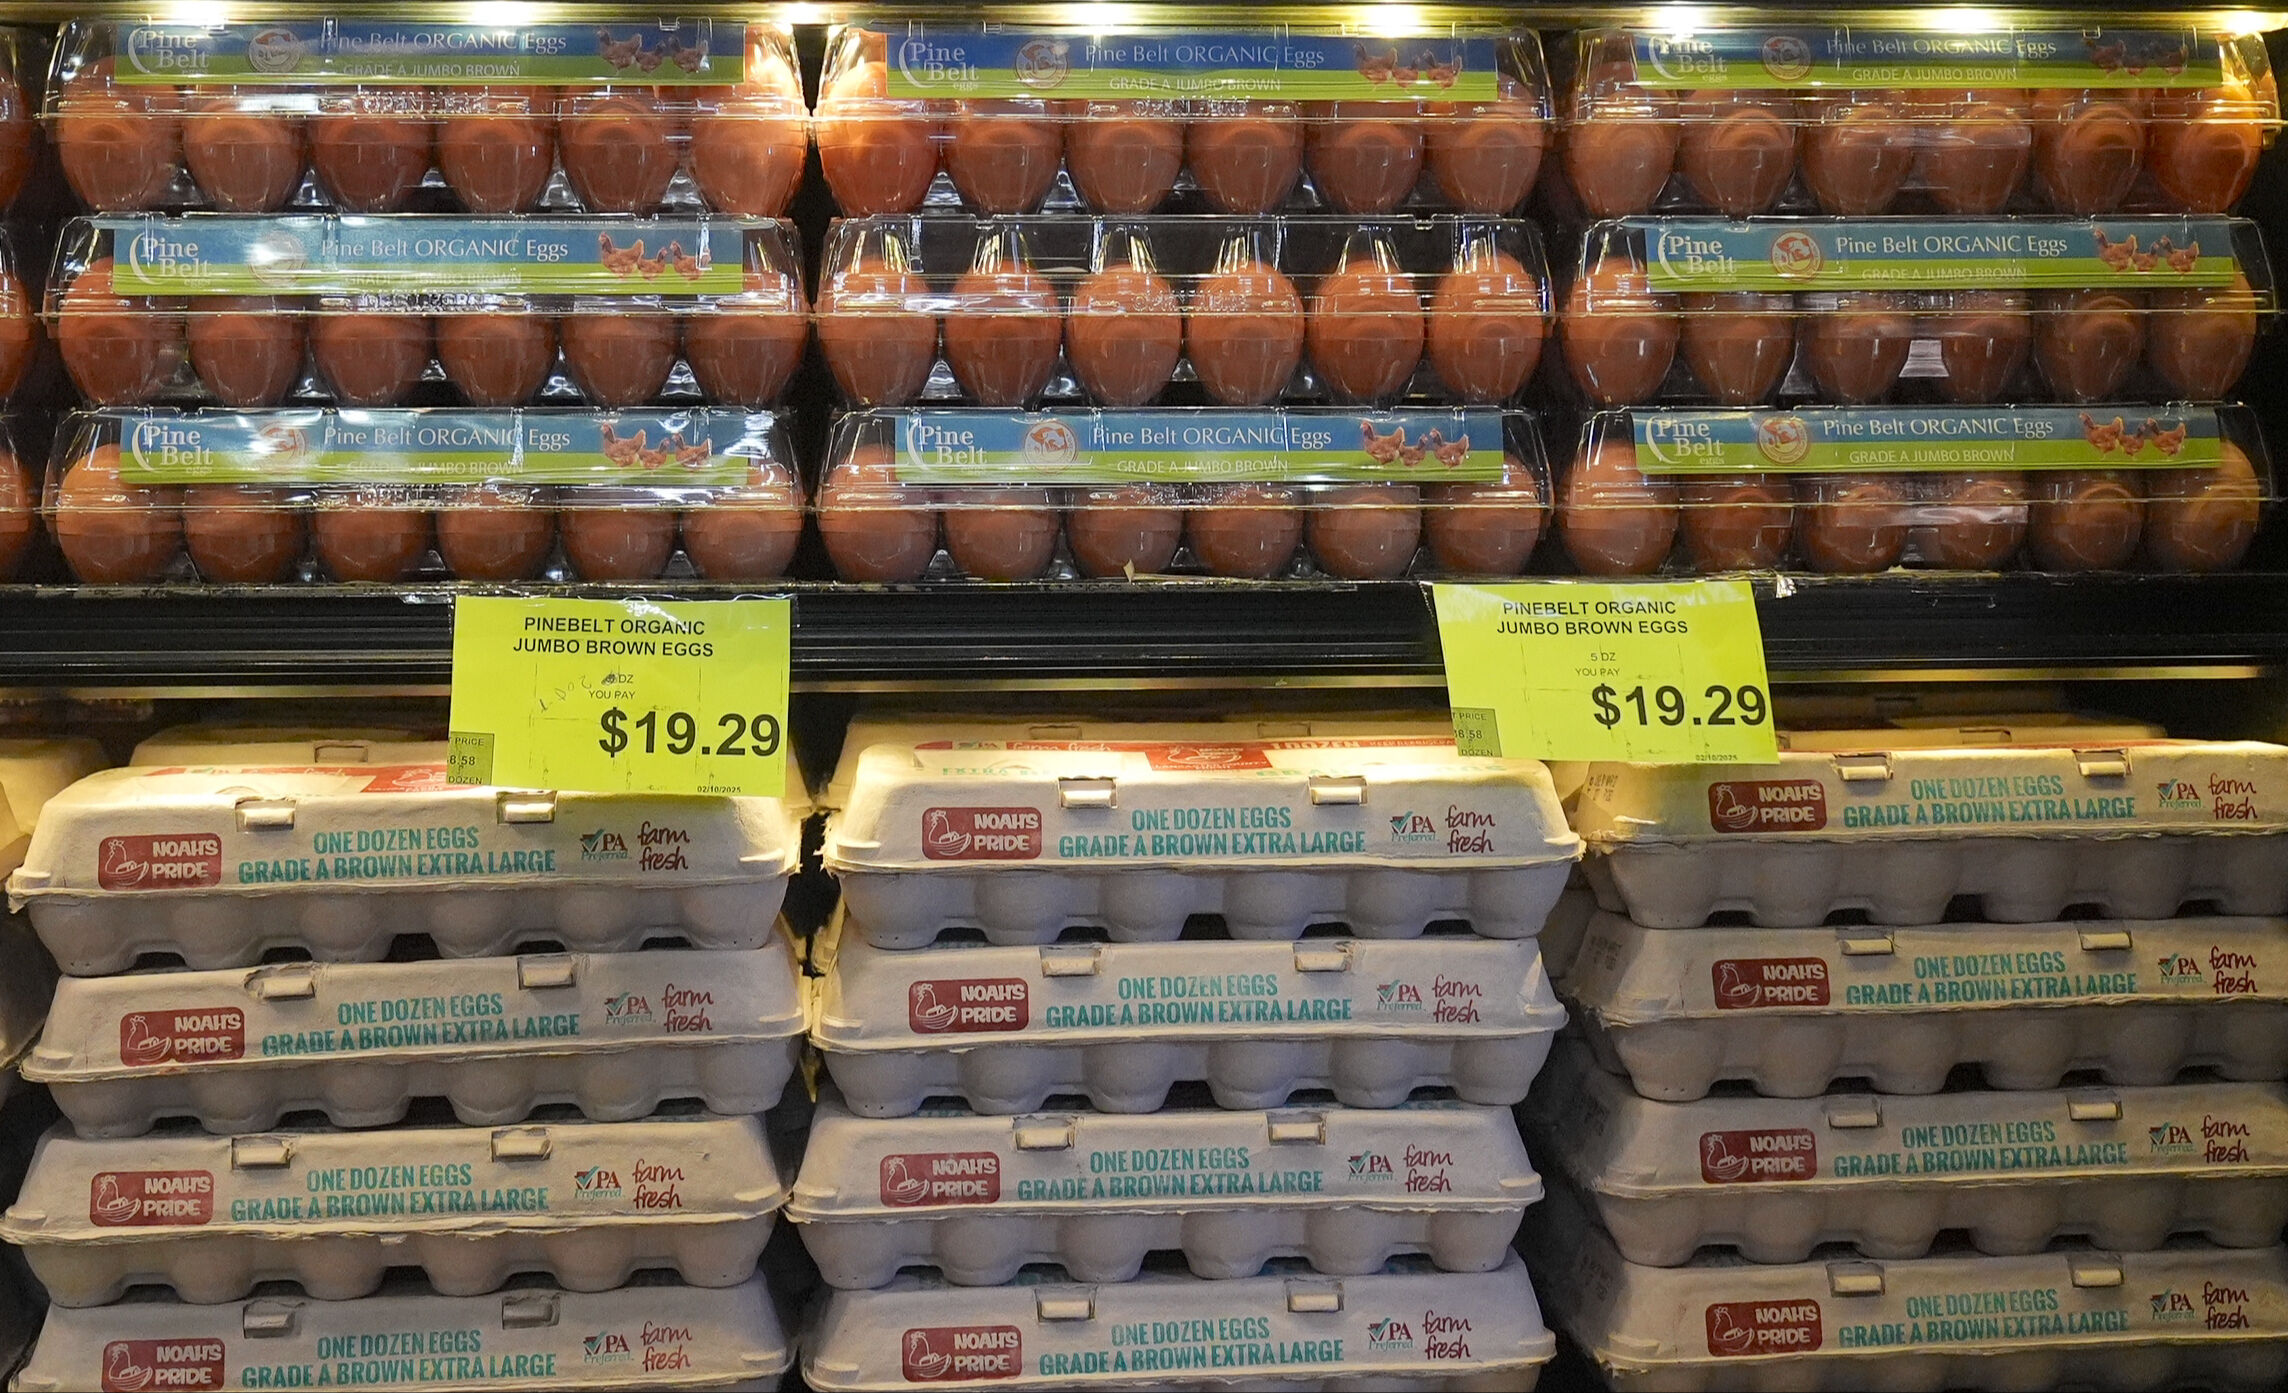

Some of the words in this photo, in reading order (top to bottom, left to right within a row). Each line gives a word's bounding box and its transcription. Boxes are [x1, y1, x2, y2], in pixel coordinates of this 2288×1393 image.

[910, 44, 966, 62] Pine
[1085, 45, 1126, 61] Pine
[1133, 45, 1170, 62] Belt
[1176, 45, 1276, 63] ORGANIC
[1283, 47, 1324, 69] Eggs
[927, 62, 980, 82] Belt
[1853, 68, 1898, 83] GRADE
[1902, 69, 1913, 81] A
[1917, 68, 1963, 82] JUMBO
[1966, 68, 2017, 82] BROWN
[1110, 78, 1156, 91] GRADE
[1161, 79, 1172, 90] A
[1227, 79, 1281, 92] BROWN
[322, 240, 364, 256] Pine
[371, 239, 409, 256] Belt
[416, 239, 519, 257] ORGANIC
[526, 240, 568, 262] Eggs
[1837, 237, 1876, 253] Pine
[1883, 237, 1918, 253] Belt
[1924, 236, 2021, 252] ORGANIC
[2028, 236, 2067, 257] Eggs
[918, 427, 974, 445] Pine
[1824, 420, 1863, 435] Pine
[1870, 419, 1905, 435] Belt
[1911, 418, 2007, 434] ORGANIC
[2014, 418, 2053, 439] Eggs
[1093, 428, 1134, 444] Pine
[1141, 427, 1177, 444] Belt
[1184, 427, 1284, 444] ORGANIC
[1291, 428, 1331, 450] Eggs
[935, 446, 988, 466] Belt
[1850, 451, 1895, 464] GRADE
[1899, 451, 1910, 462] A
[1914, 450, 1960, 462] JUMBO
[1963, 449, 2014, 462] BROWN
[1117, 461, 1164, 475] GRADE
[1168, 461, 1180, 473] A
[1184, 460, 1232, 473] JUMBO
[1235, 460, 1288, 474] BROWN
[1503, 601, 1589, 616] PINEBELT
[1595, 600, 1677, 615] ORGANIC
[525, 617, 615, 633] PINEBELT
[621, 619, 705, 636] ORGANIC
[1497, 621, 1560, 635] JUMBO
[1566, 621, 1633, 634] BROWN
[1639, 620, 1689, 634] EGGS
[513, 638, 580, 654] JUMBO
[586, 641, 655, 656] BROWN
[662, 643, 713, 657] EGGS
[1590, 652, 1598, 661] 5
[1600, 652, 1616, 661] DZ
[1575, 668, 1597, 677] YOU
[1600, 668, 1620, 677] PAY
[590, 690, 611, 699] YOU
[614, 690, 635, 699] PAY
[1591, 683, 1767, 731] $19.29
[1459, 713, 1487, 721] PRICE
[455, 737, 484, 746] PRICE
[599, 707, 780, 757] $19.29
[1461, 749, 1493, 757] DOZEN
[448, 776, 482, 785] DOZEN
[1759, 785, 1822, 802] NOAH'S
[974, 813, 1039, 829] NOAH'S
[1132, 810, 1169, 831] ONE
[1173, 808, 1234, 830] DOZEN
[1240, 807, 1291, 828] EGGS
[1445, 804, 1496, 828] farm
[1761, 806, 1815, 823] PRIDE
[1411, 816, 1435, 833] PA
[152, 839, 219, 857] NOAH'S
[974, 834, 1030, 851] PRIDE
[1059, 836, 1128, 857] GRADE
[1132, 836, 1148, 856] A
[1152, 834, 1227, 855] BROWN
[1232, 833, 1298, 854] EXTRA
[1300, 832, 1365, 853] LARGE
[1447, 829, 1494, 853] fresh
[152, 861, 209, 880] PRIDE
[1914, 957, 1949, 979] ONE
[1953, 954, 2011, 977] DOZEN
[2016, 952, 2065, 973] EGGS
[2178, 958, 2200, 975] PA
[2209, 945, 2256, 969] farm
[1762, 964, 1825, 980] NOAH'S
[1119, 978, 1156, 1000] ONE
[1160, 976, 1221, 999] DOZEN
[1227, 974, 1278, 996] EGGS
[1765, 983, 1819, 1000] PRIDE
[1846, 984, 1912, 1006] GRADE
[1916, 984, 1931, 1004] A
[1935, 980, 2006, 1003] BROWN
[2011, 977, 2073, 999] EXTRA
[2075, 974, 2136, 996] LARGE
[2213, 970, 2257, 994] fresh
[337, 1002, 376, 1026] ONE
[380, 997, 444, 1023] DOZEN
[450, 993, 504, 1017] EGGS
[632, 1157, 686, 1183] farm
[932, 1157, 997, 1176] NOAH'S
[144, 1176, 211, 1194] NOAH'S
[307, 1170, 345, 1192] ONE
[350, 1166, 413, 1190] DOZEN
[419, 1164, 472, 1187] EGGS
[596, 1171, 621, 1189] PA
[633, 1183, 682, 1209] fresh
[932, 1179, 988, 1197] PRIDE
[143, 1198, 201, 1217] PRIDE
[231, 1198, 302, 1221] GRADE
[306, 1197, 323, 1218] A
[327, 1193, 405, 1217] BROWN
[410, 1191, 478, 1214] EXTRA
[480, 1188, 548, 1211] LARGE
[1422, 1308, 1473, 1334] farm
[1755, 1304, 1818, 1324] NOAH'S
[954, 1331, 1019, 1350] NOAH'S
[1111, 1324, 1148, 1347] ONE
[1152, 1320, 1213, 1345] DOZEN
[1219, 1317, 1270, 1340] EGGS
[1388, 1322, 1412, 1340] PA
[1757, 1326, 1811, 1346] PRIDE
[1424, 1334, 1471, 1359] fresh
[954, 1353, 1010, 1372] PRIDE
[1039, 1352, 1108, 1376] GRADE
[1112, 1352, 1128, 1372] A
[1132, 1347, 1206, 1371] BROWN
[1211, 1343, 1277, 1367] EXTRA
[1279, 1340, 1343, 1364] LARGE
